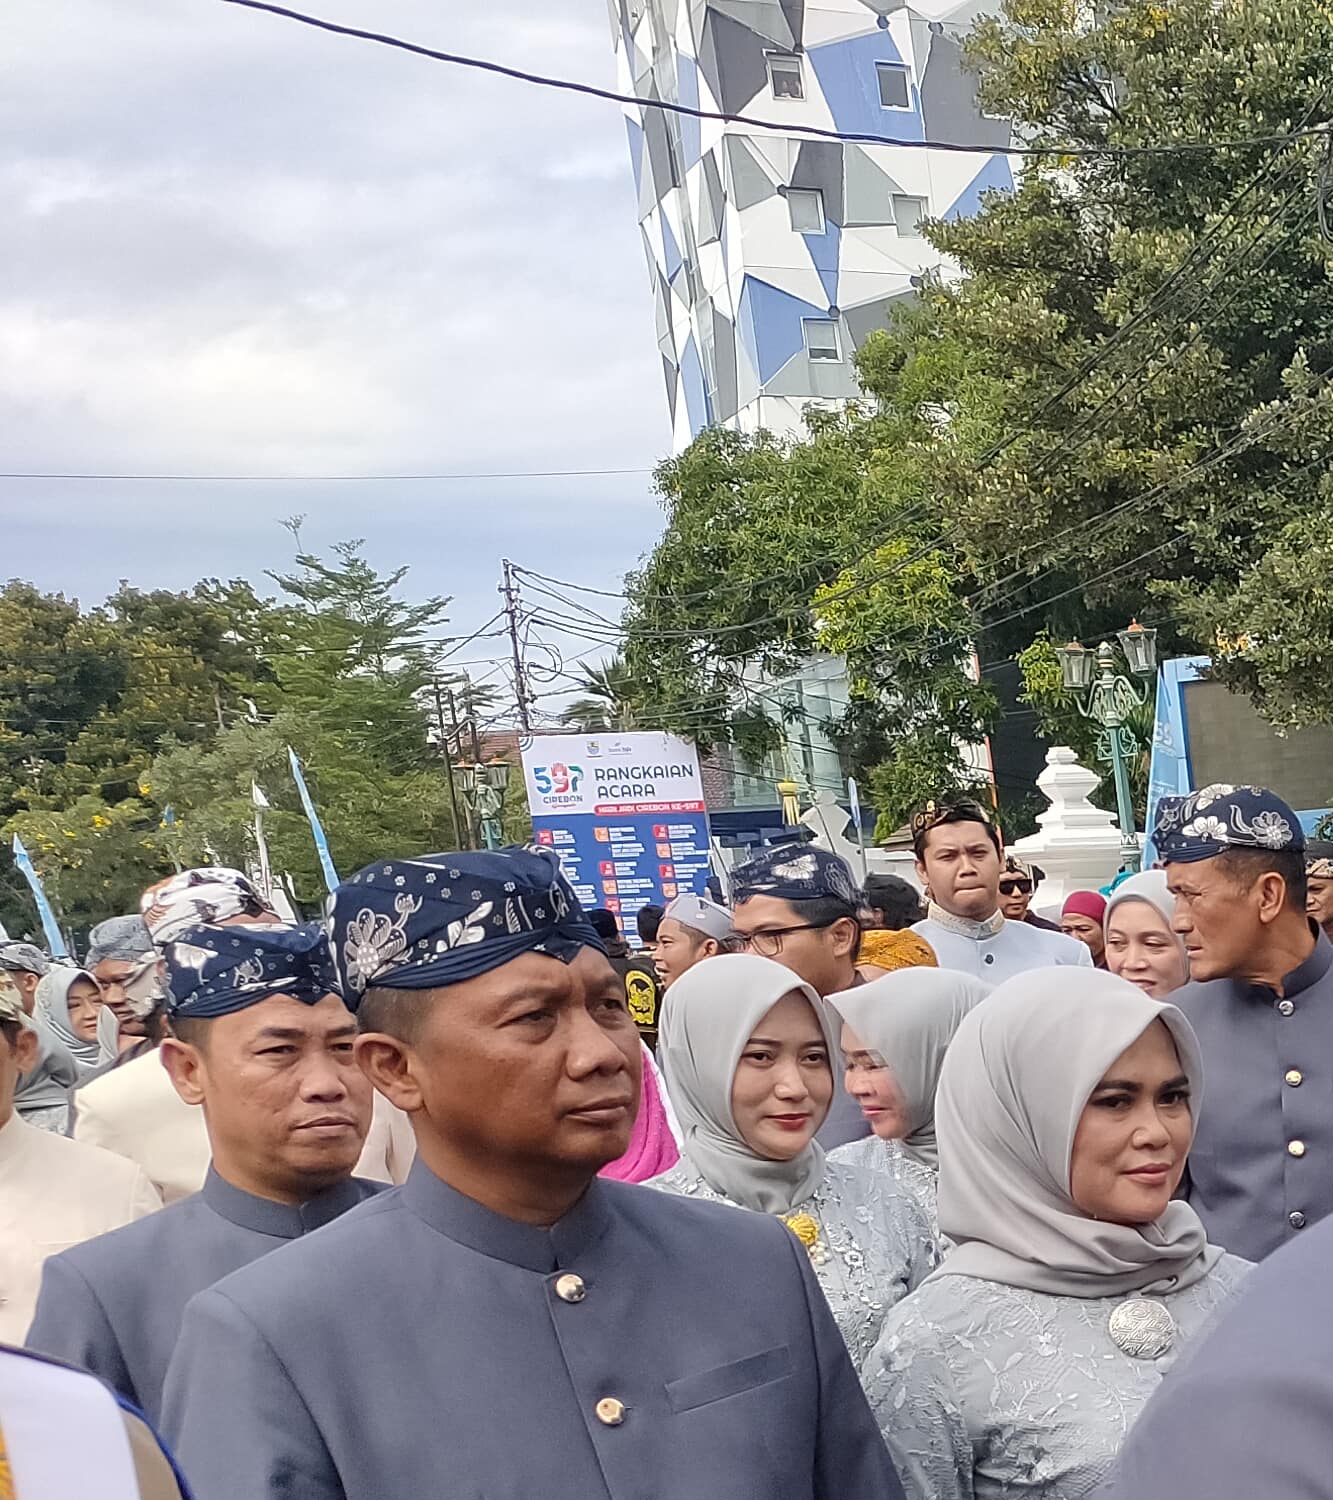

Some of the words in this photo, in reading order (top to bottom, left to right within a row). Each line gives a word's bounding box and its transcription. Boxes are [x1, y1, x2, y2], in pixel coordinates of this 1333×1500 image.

[533, 762, 584, 793] 597
[594, 764, 693, 781] RANGKAIAN
[597, 783, 656, 799] ACARA
[543, 795, 583, 804] CIREBON
